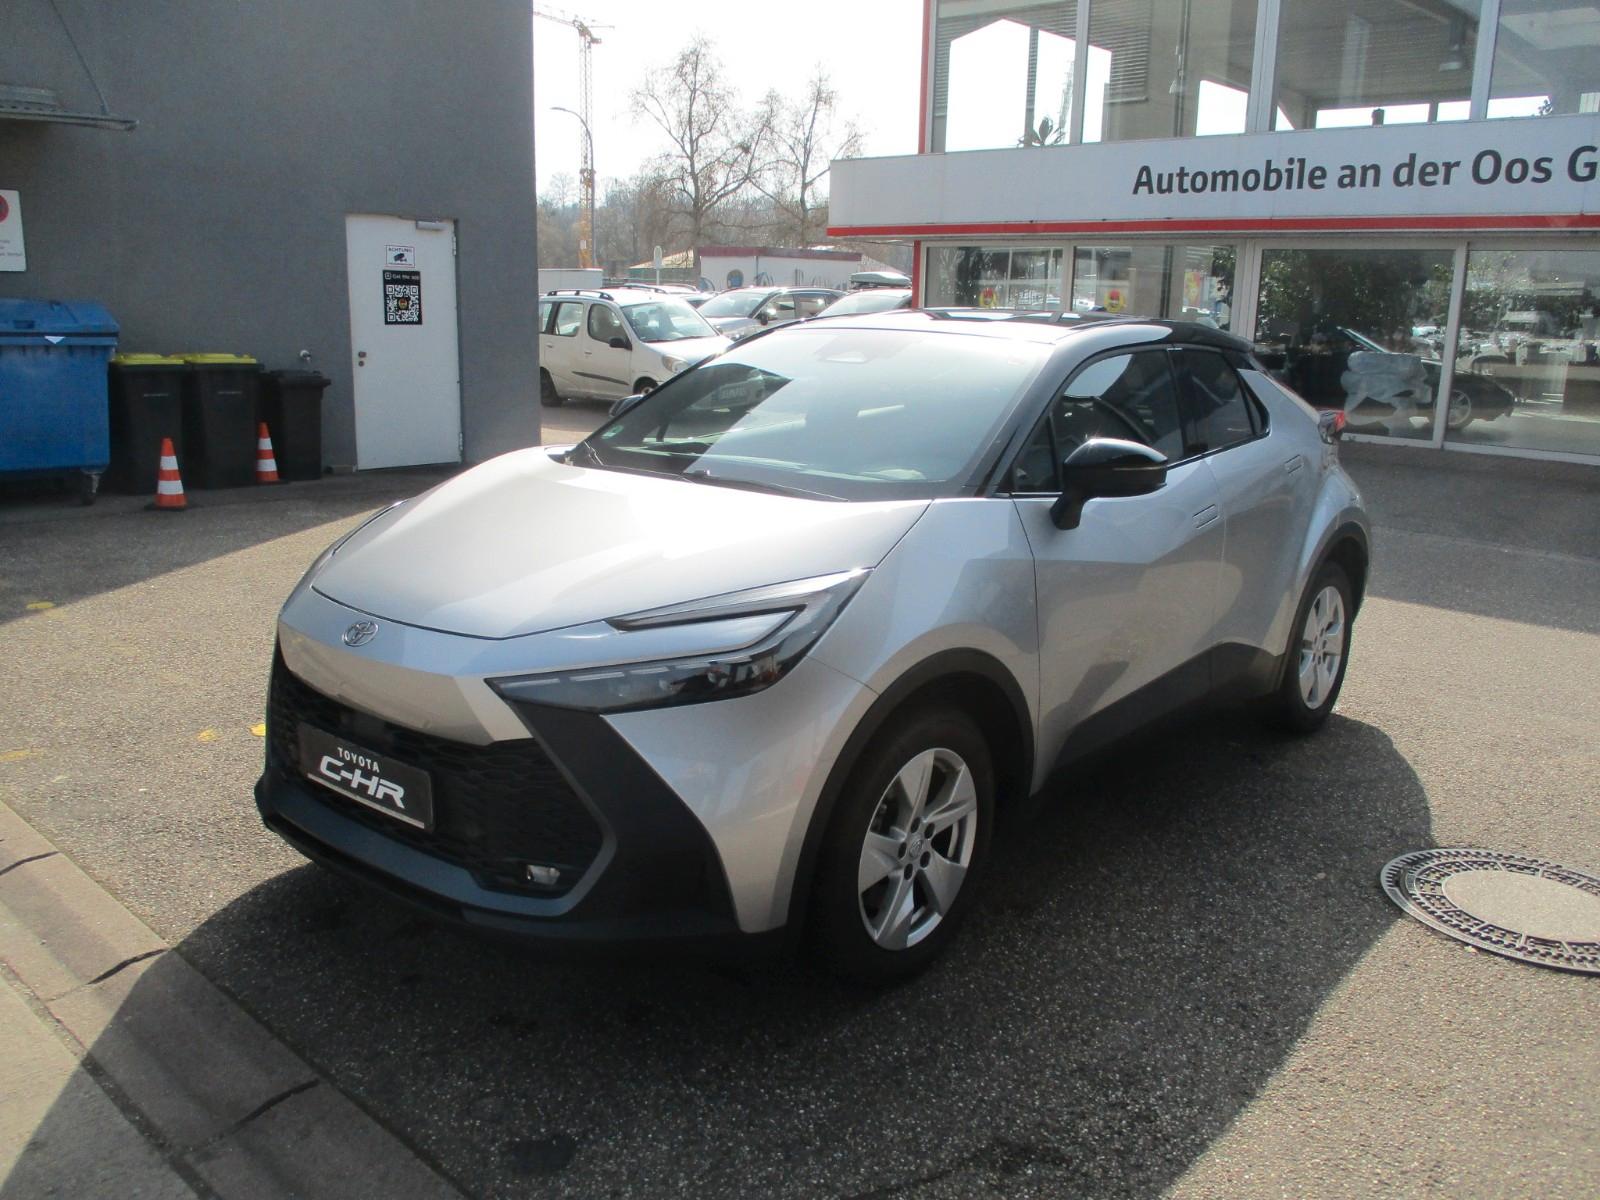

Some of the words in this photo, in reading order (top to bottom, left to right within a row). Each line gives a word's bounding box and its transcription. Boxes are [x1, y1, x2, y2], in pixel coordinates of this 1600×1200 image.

[1132, 157, 1327, 195] Automobile
[1337, 162, 1381, 188] an
[1392, 153, 1461, 187] der
[1471, 149, 1553, 185] Oos
[1567, 145, 1598, 182] G
[320, 755, 405, 809] C-HR
[337, 747, 380, 773] TOYOTA
